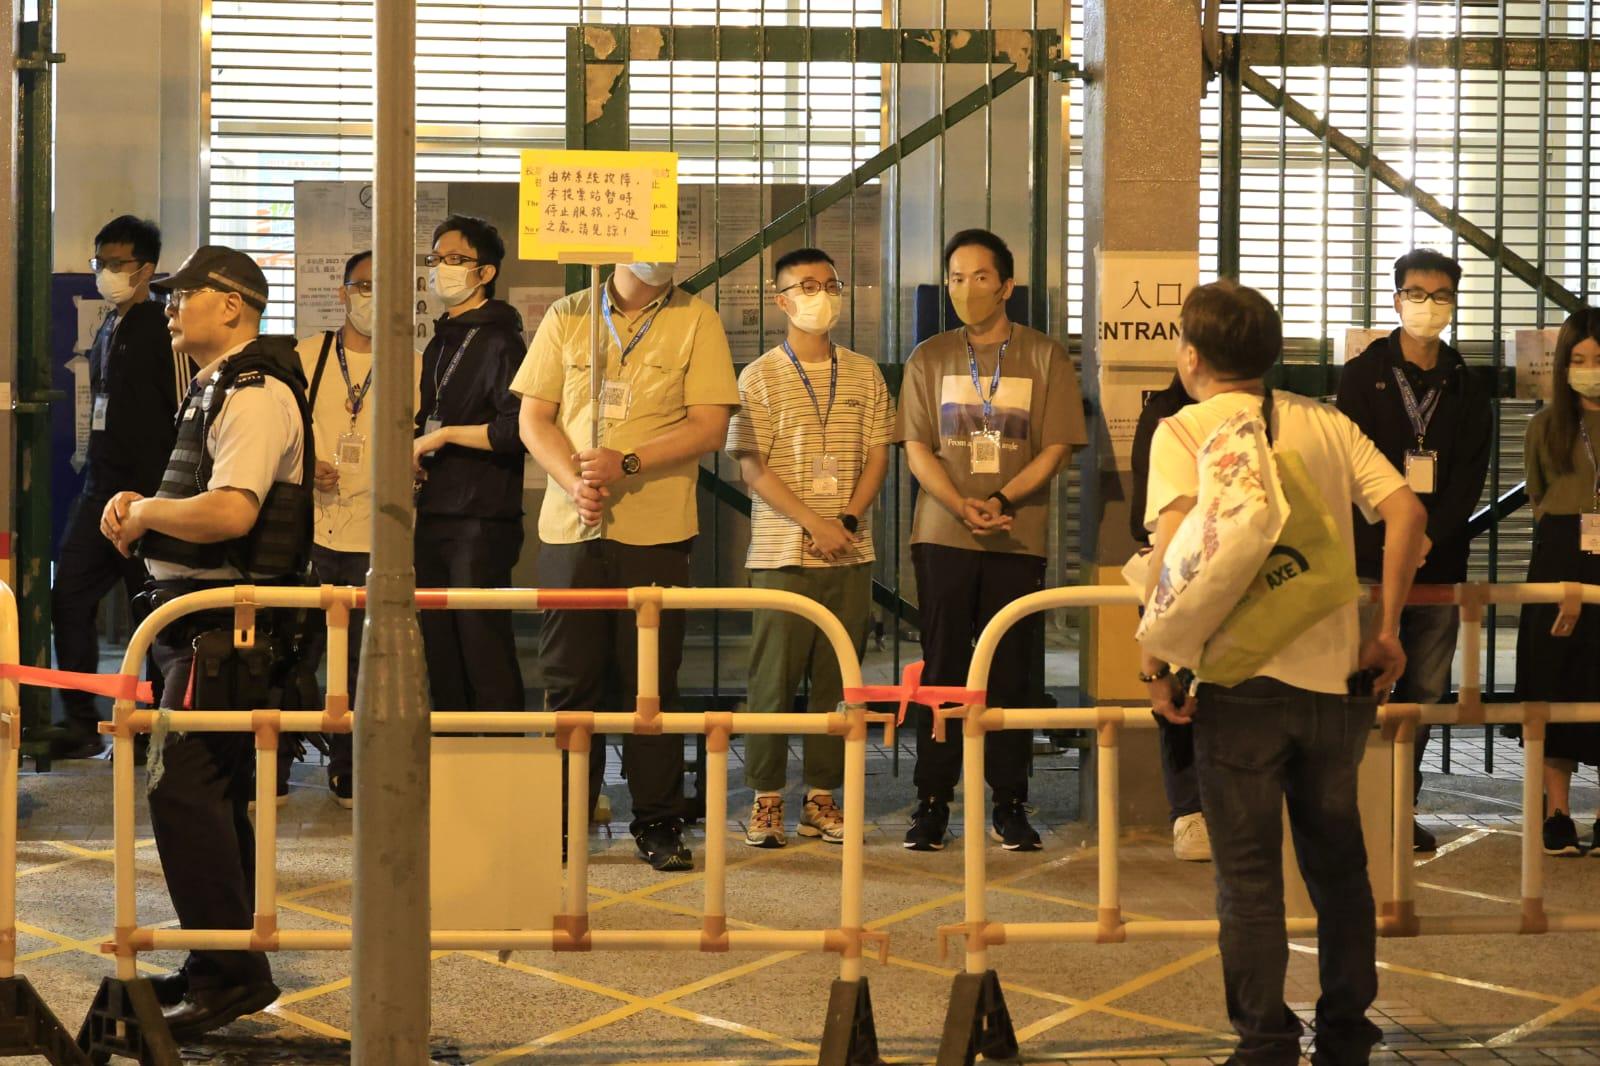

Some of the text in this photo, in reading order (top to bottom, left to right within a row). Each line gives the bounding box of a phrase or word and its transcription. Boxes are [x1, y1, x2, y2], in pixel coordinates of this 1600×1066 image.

[1121, 280, 1183, 309] 入口
[1098, 321, 1180, 340] NTRAN
[1265, 562, 1297, 590] AXE
